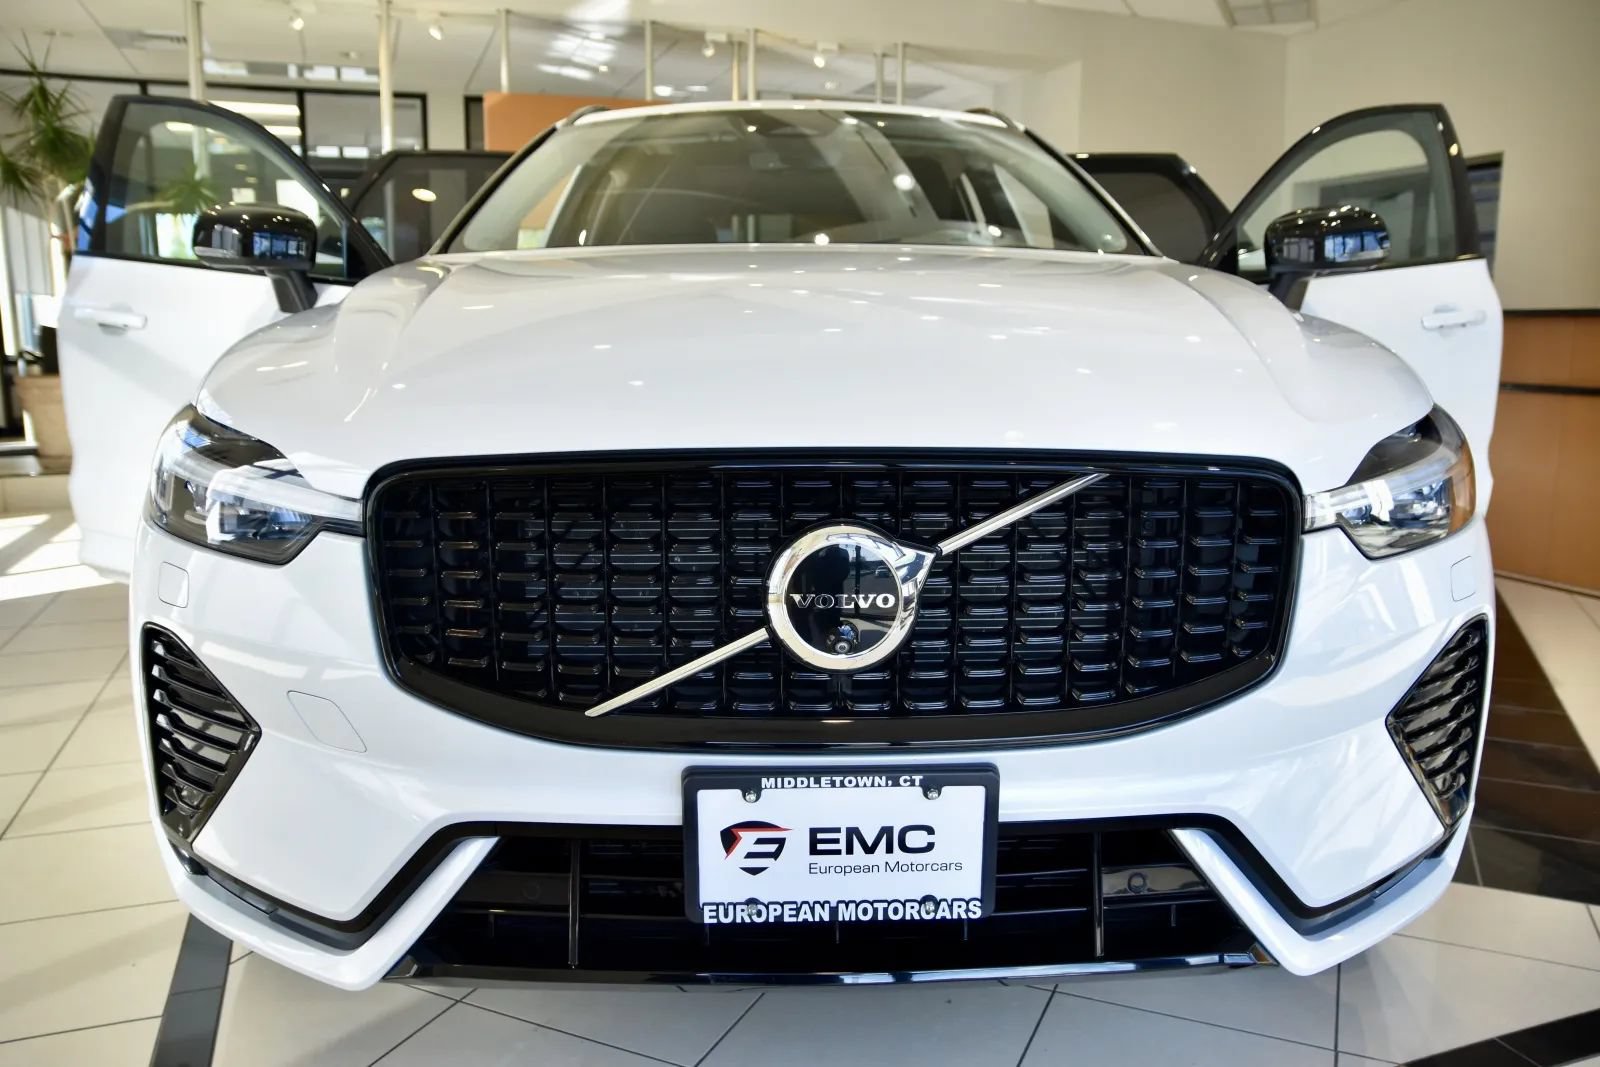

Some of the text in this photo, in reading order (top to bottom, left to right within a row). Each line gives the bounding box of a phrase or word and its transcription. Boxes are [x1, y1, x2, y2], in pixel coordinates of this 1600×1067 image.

[789, 593, 896, 609] VOLVO
[761, 775, 923, 788] MIDDLETOWN, CT
[808, 824, 936, 856] EMC
[808, 860, 963, 876] European Motorcars
[703, 900, 982, 924] EUROPEAN MOTORCARS
